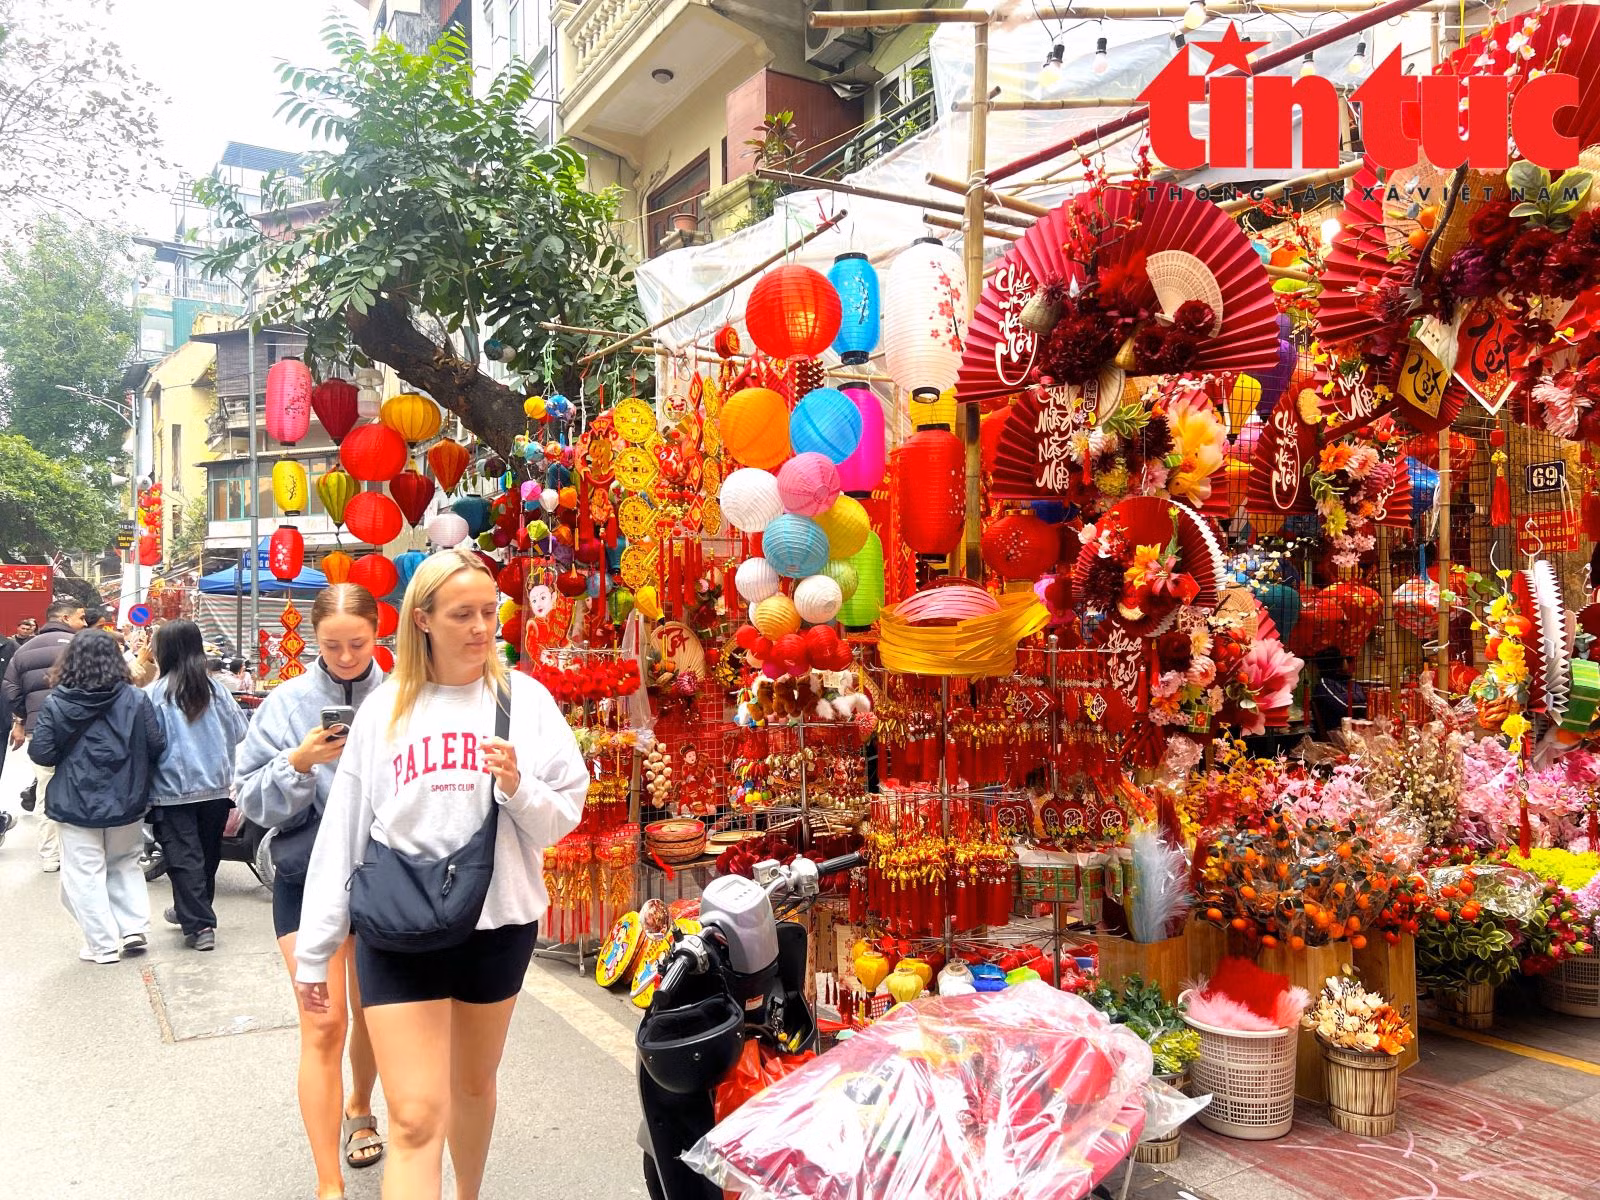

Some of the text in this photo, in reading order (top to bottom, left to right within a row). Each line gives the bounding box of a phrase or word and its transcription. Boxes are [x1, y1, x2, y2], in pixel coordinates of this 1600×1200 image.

[1532, 465, 1558, 488] 69
[393, 732, 490, 797] PALER
[431, 783, 475, 792] SPORTS CLUB
